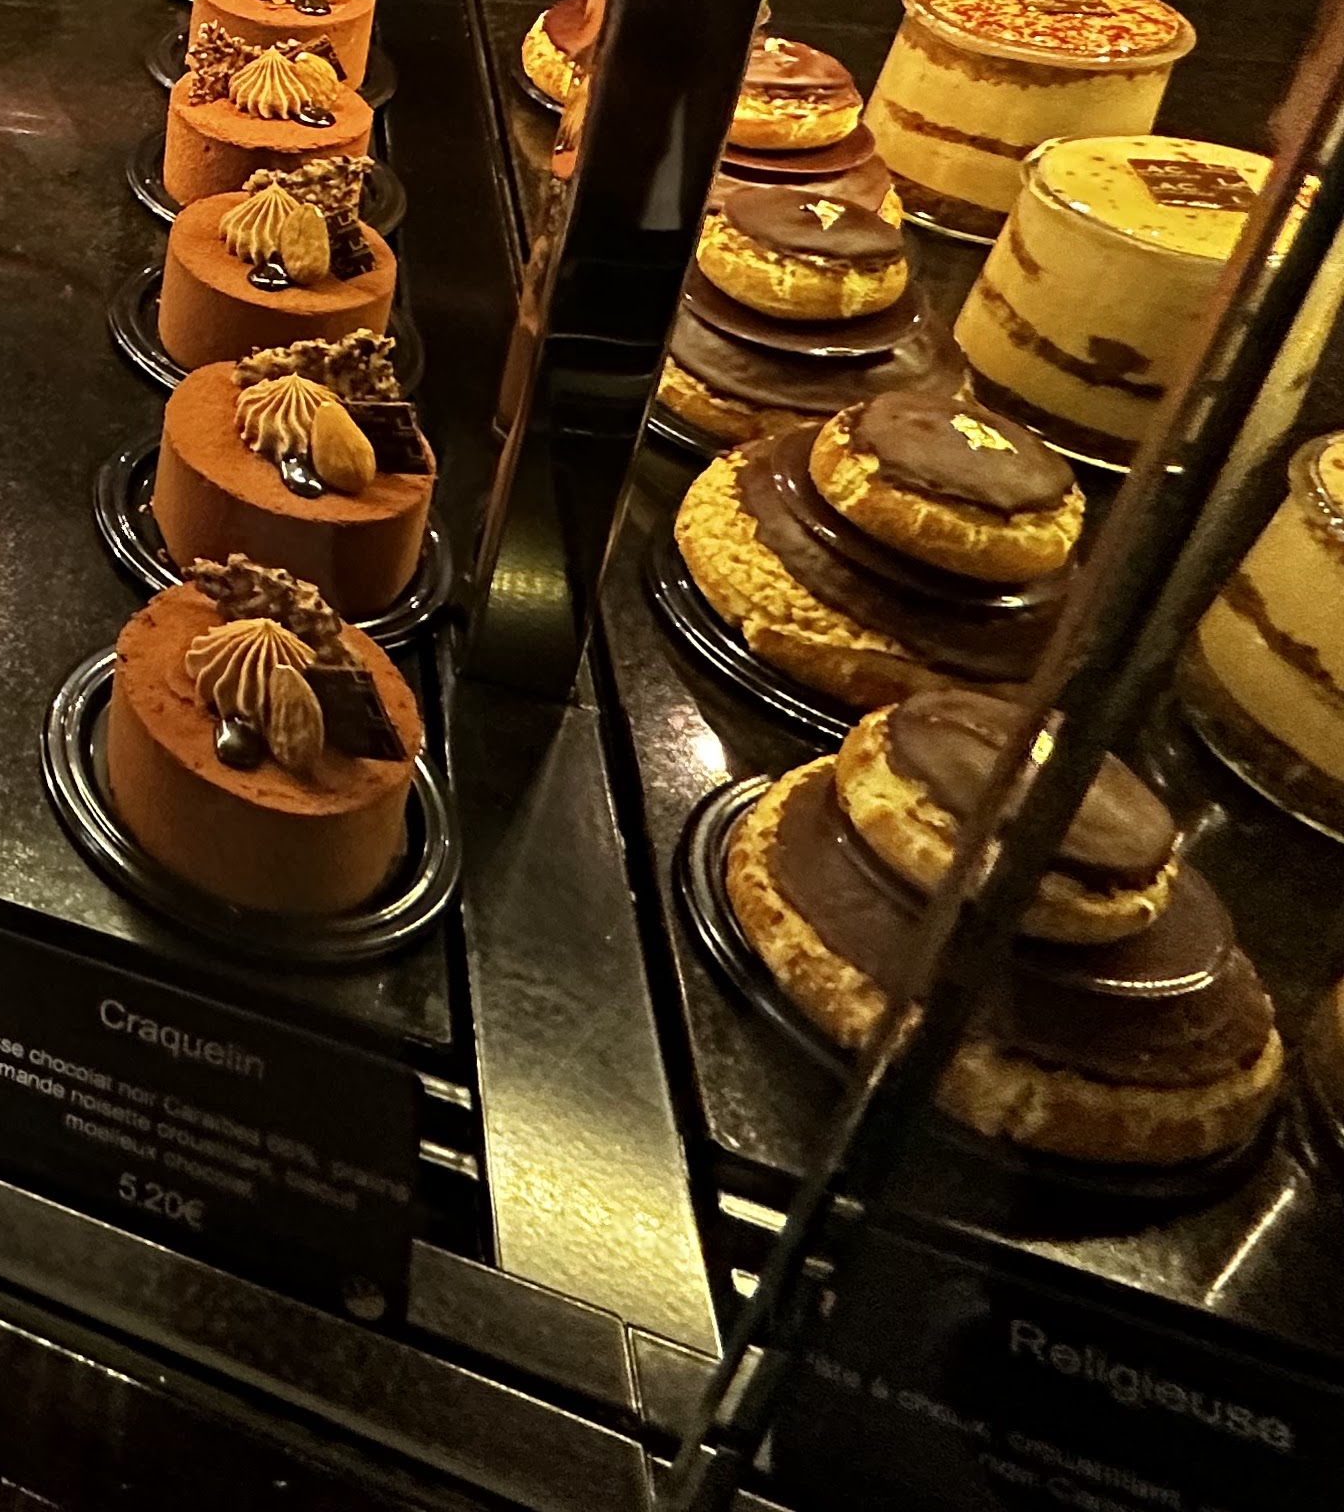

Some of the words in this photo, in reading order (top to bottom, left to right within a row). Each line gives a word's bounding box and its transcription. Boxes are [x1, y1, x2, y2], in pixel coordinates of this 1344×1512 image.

[29, 1049, 111, 1089] chocolat
[99, 998, 266, 1080] Craquelin
[71, 1090, 150, 1130] noisette
[1009, 1319, 1296, 1452] Religieuse
